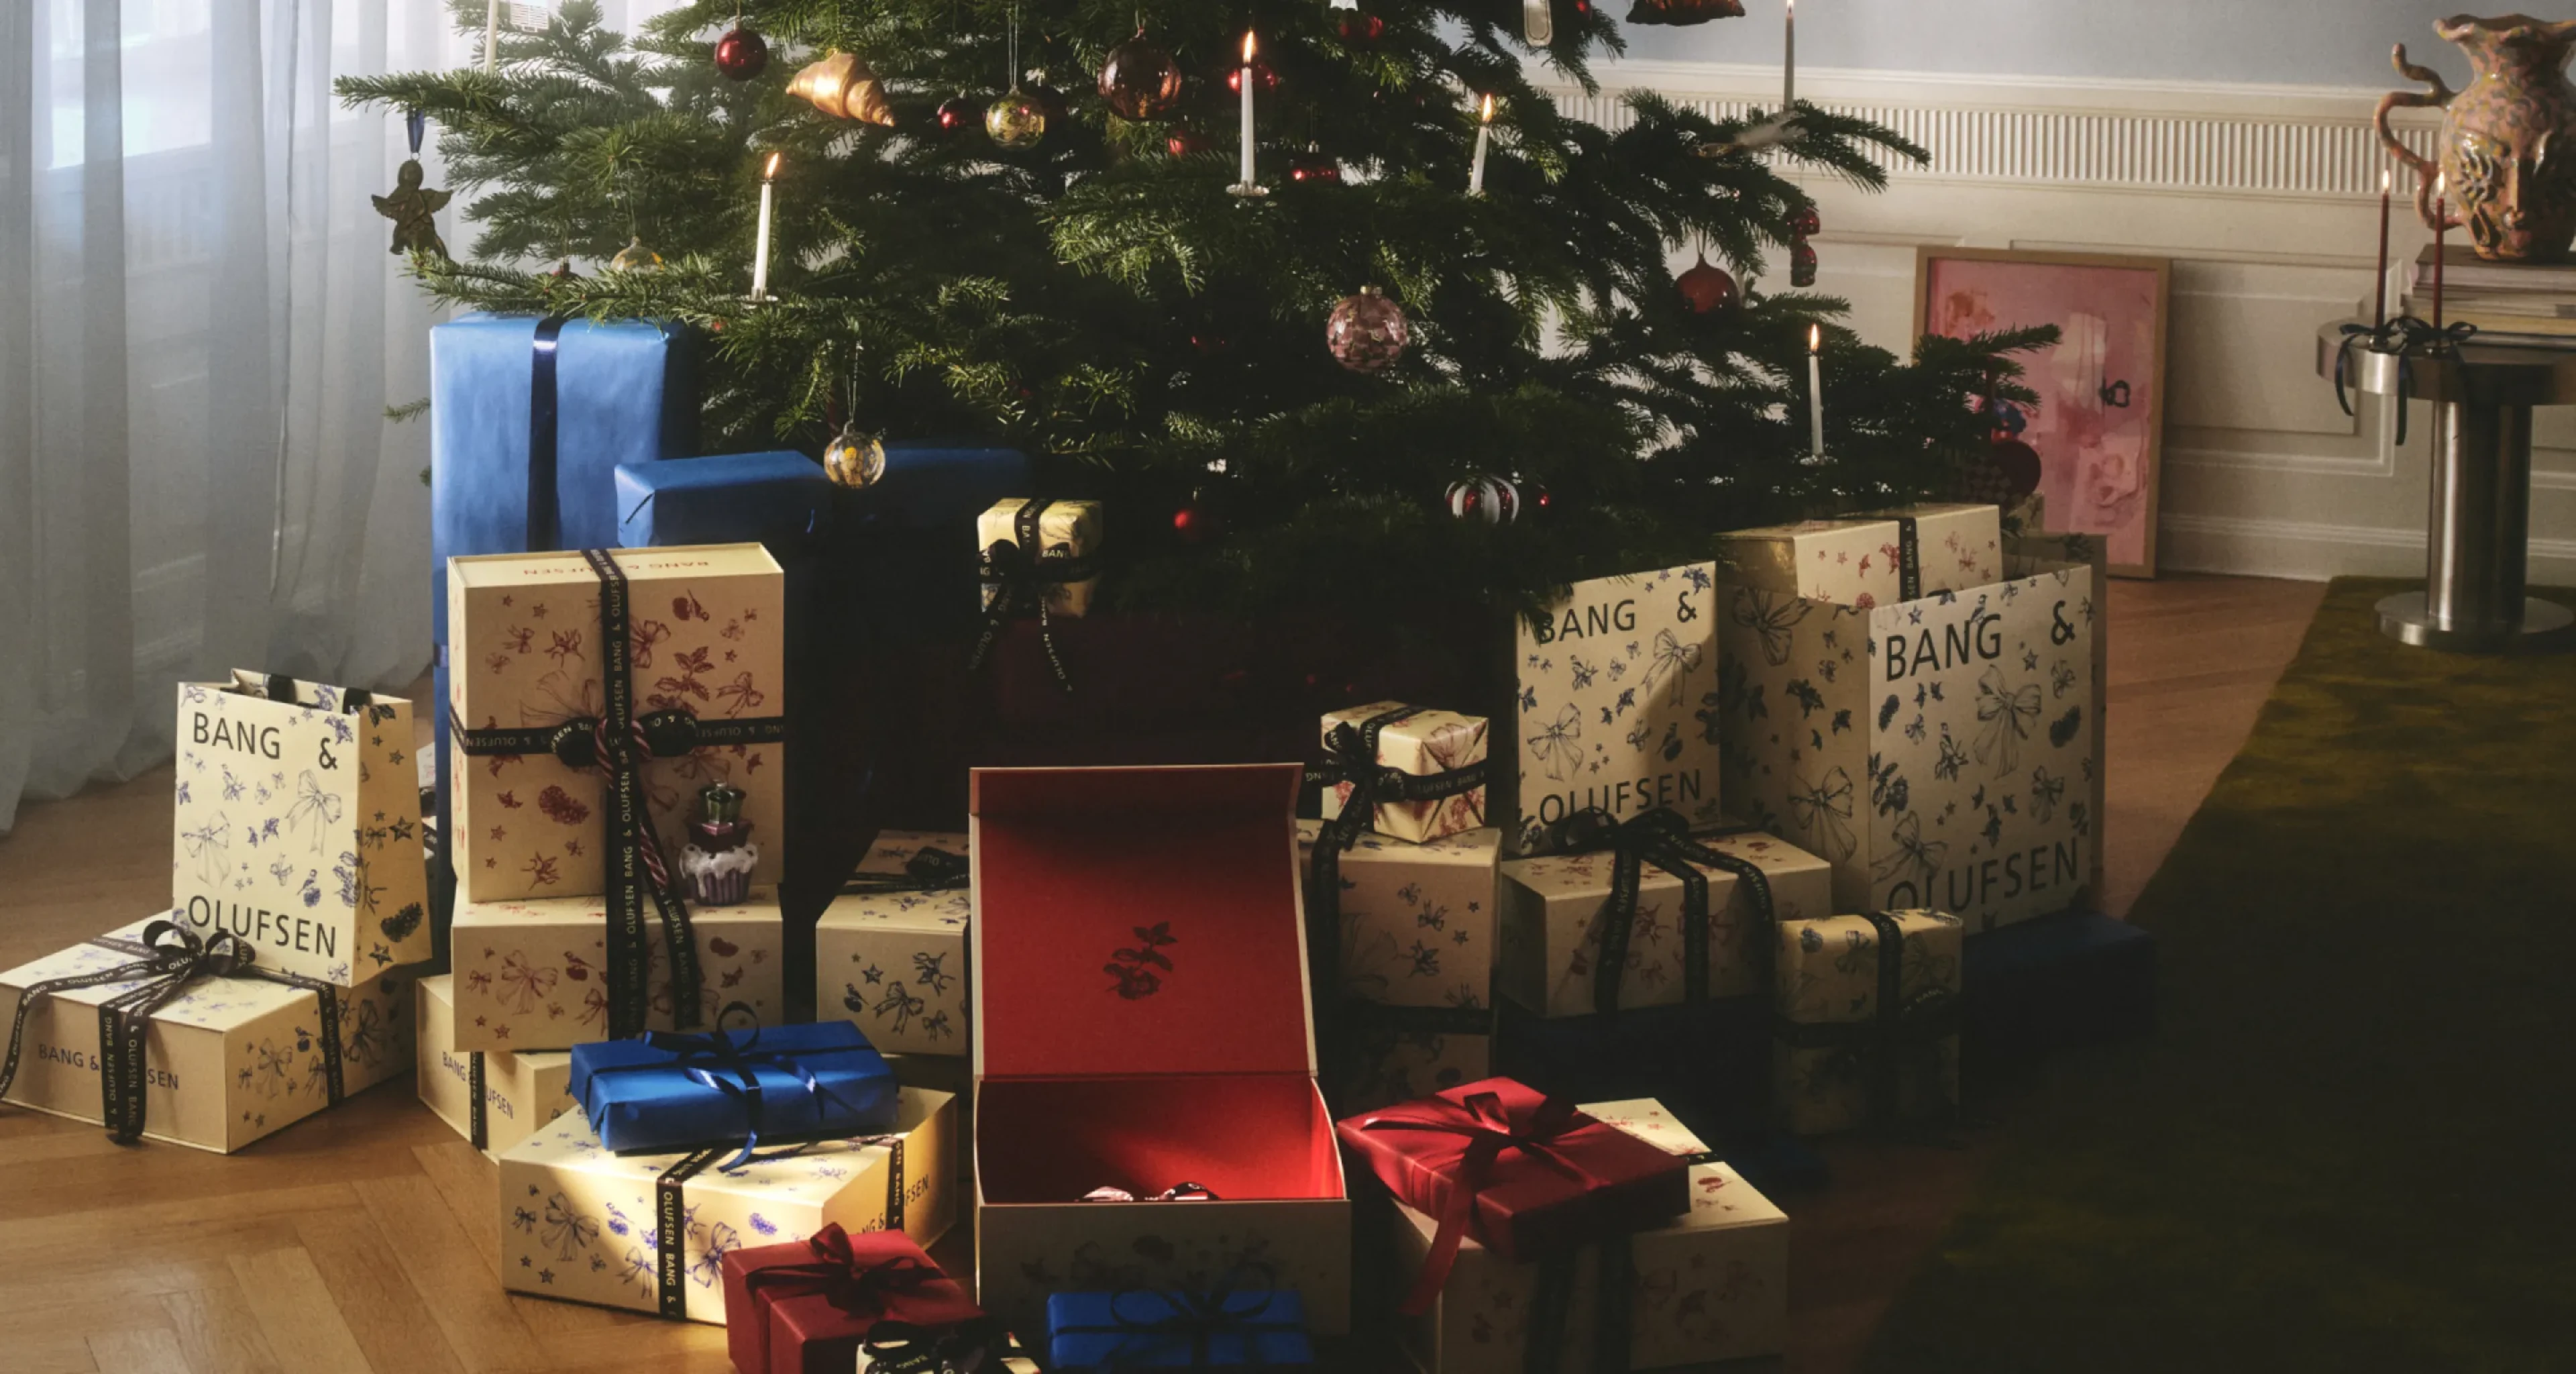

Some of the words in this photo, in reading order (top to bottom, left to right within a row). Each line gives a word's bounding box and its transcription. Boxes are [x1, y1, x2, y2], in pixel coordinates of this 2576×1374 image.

[1539, 598, 1635, 645] BANG
[1676, 590, 1697, 623] &
[1886, 613, 2001, 682] BANG
[2051, 600, 2076, 645] &
[612, 641, 623, 672] BANG
[193, 711, 281, 759] BANG
[319, 737, 338, 770] &
[621, 772, 631, 822] OLUFSEN
[624, 845, 633, 878] BANG
[1886, 837, 2077, 913] OLUFSEN
[189, 895, 336, 958] OLUFSEN
[625, 885, 636, 935] OLUFSEN
[105, 1016, 113, 1047] BANG
[38, 1043, 84, 1068] BANG
[89, 1054, 100, 1071] &
[107, 1053, 117, 1101] OLUFSEN
[128, 1039, 138, 1088] OLUFSEN
[442, 1051, 466, 1082] BANG
[663, 1191, 675, 1246] OLUFSEN
[665, 1253, 676, 1287] BANG
[666, 1295, 677, 1304] &
